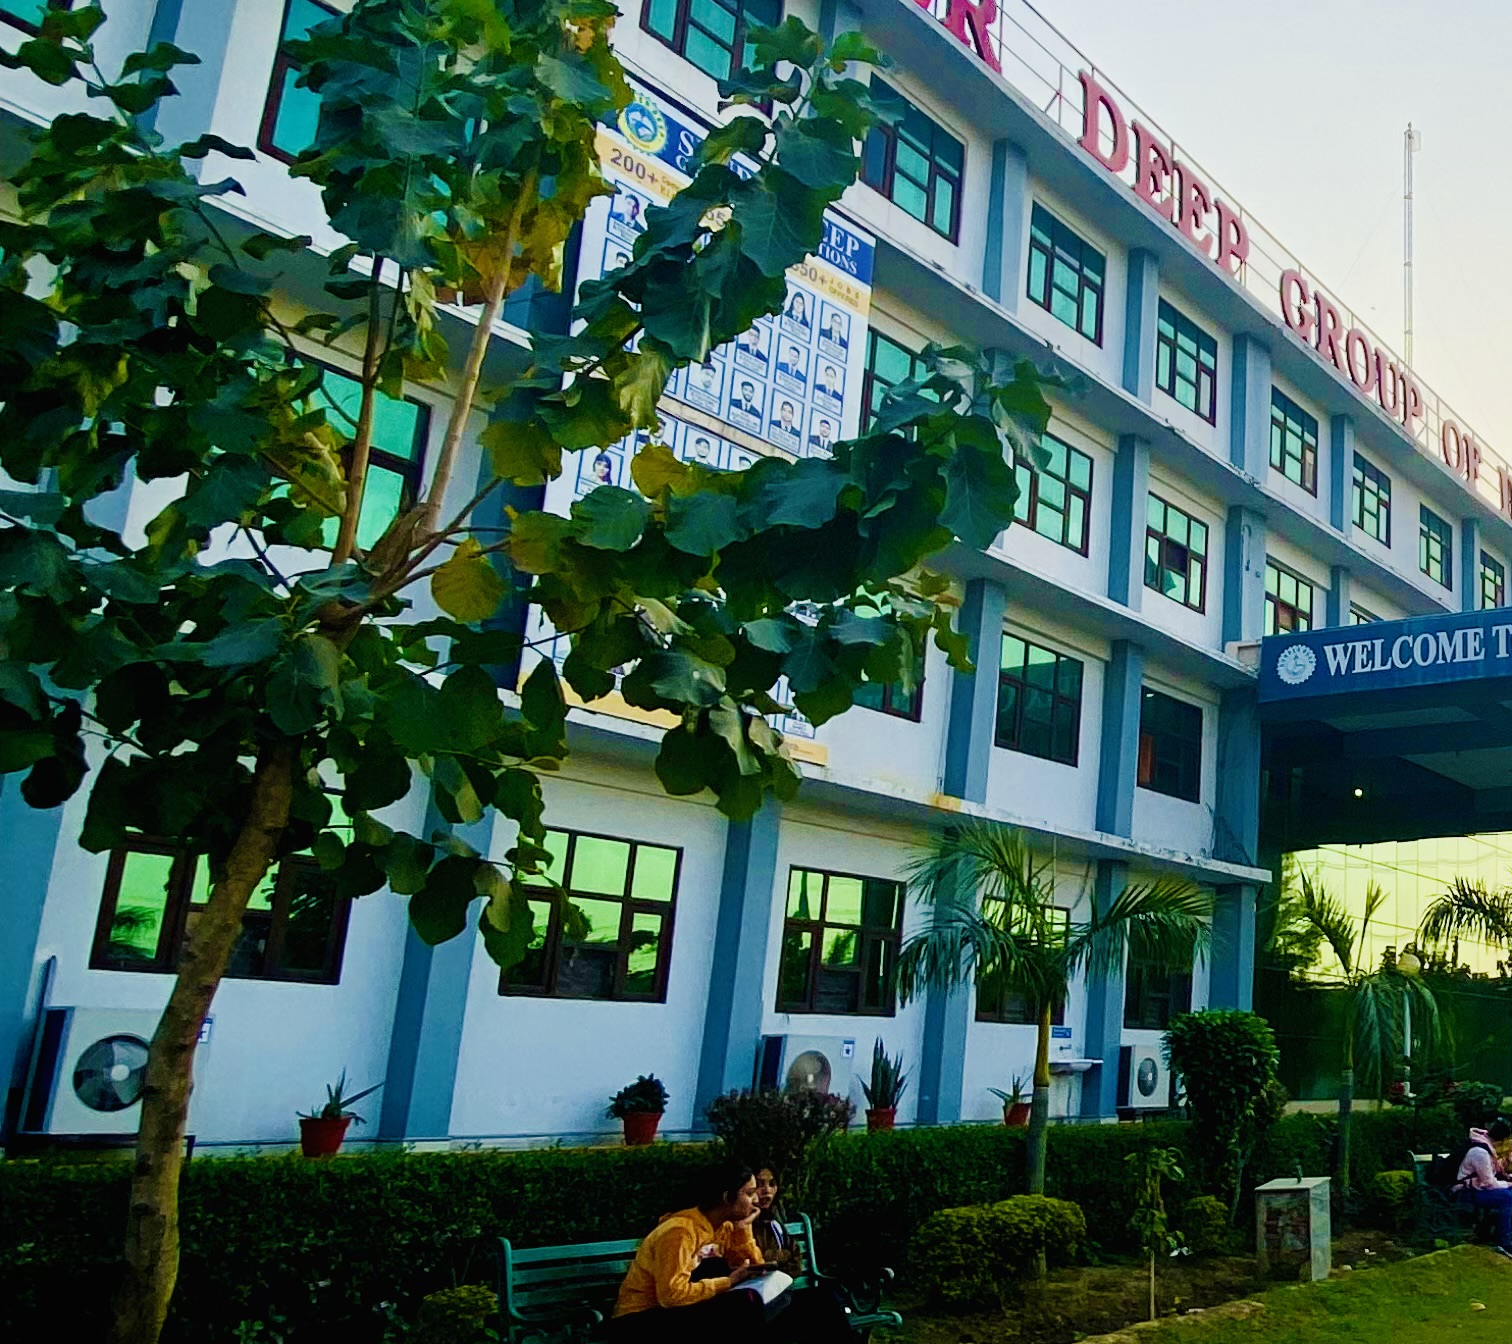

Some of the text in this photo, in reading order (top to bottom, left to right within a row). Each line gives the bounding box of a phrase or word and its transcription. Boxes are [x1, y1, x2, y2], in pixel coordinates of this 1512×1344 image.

[610, 148, 658, 185] 200+
[1076, 69, 1249, 280] DEEP
[1279, 268, 1424, 438] GROUP
[1441, 419, 1482, 493] OF
[1323, 627, 1486, 677] WELCOME
